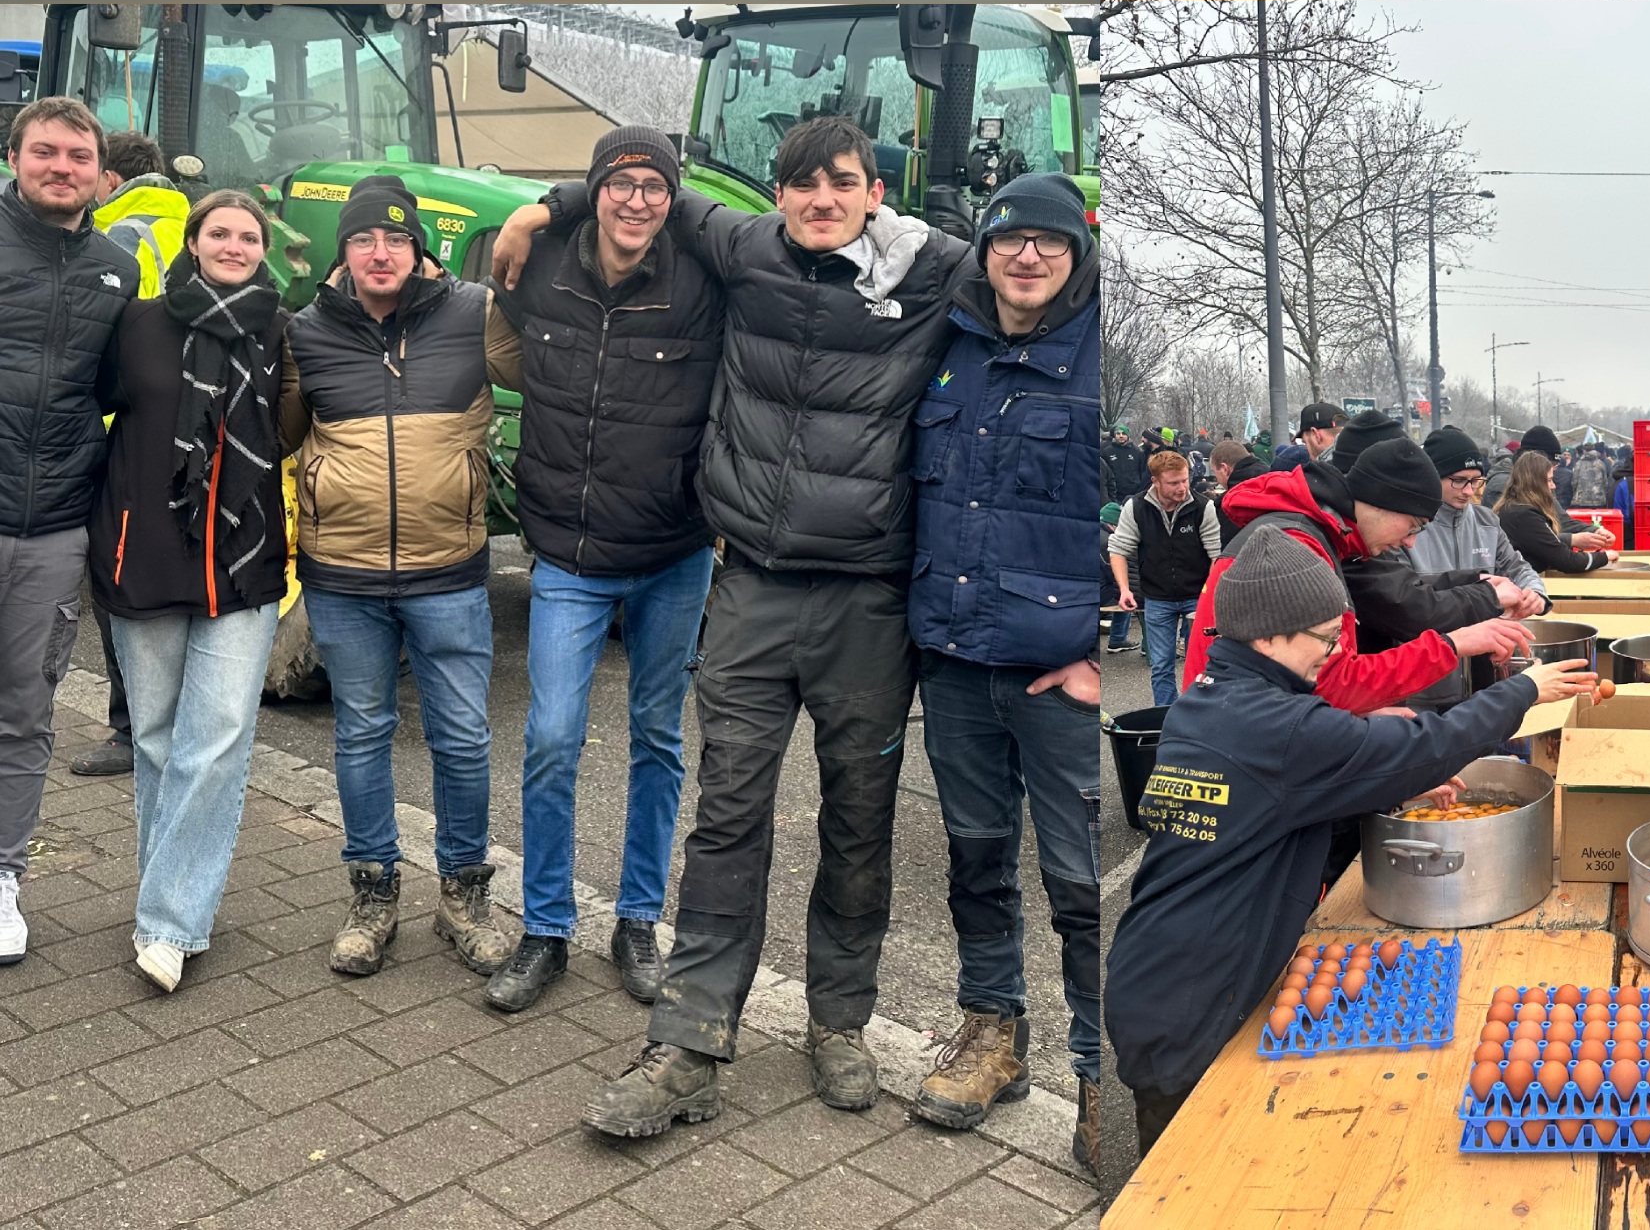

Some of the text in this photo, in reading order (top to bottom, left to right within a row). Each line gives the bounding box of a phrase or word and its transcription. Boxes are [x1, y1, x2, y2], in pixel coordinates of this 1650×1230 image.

[321, 187, 347, 200] DEERE
[437, 217, 466, 233] 6830
[1197, 784, 1222, 801] TP
[1170, 810, 1185, 820] 72
[1187, 811, 1200, 824] 20
[1202, 815, 1217, 827] 98
[1199, 831, 1217, 842] 05
[1581, 847, 1621, 859] Alvéole
[1586, 860, 1615, 871] x 360
